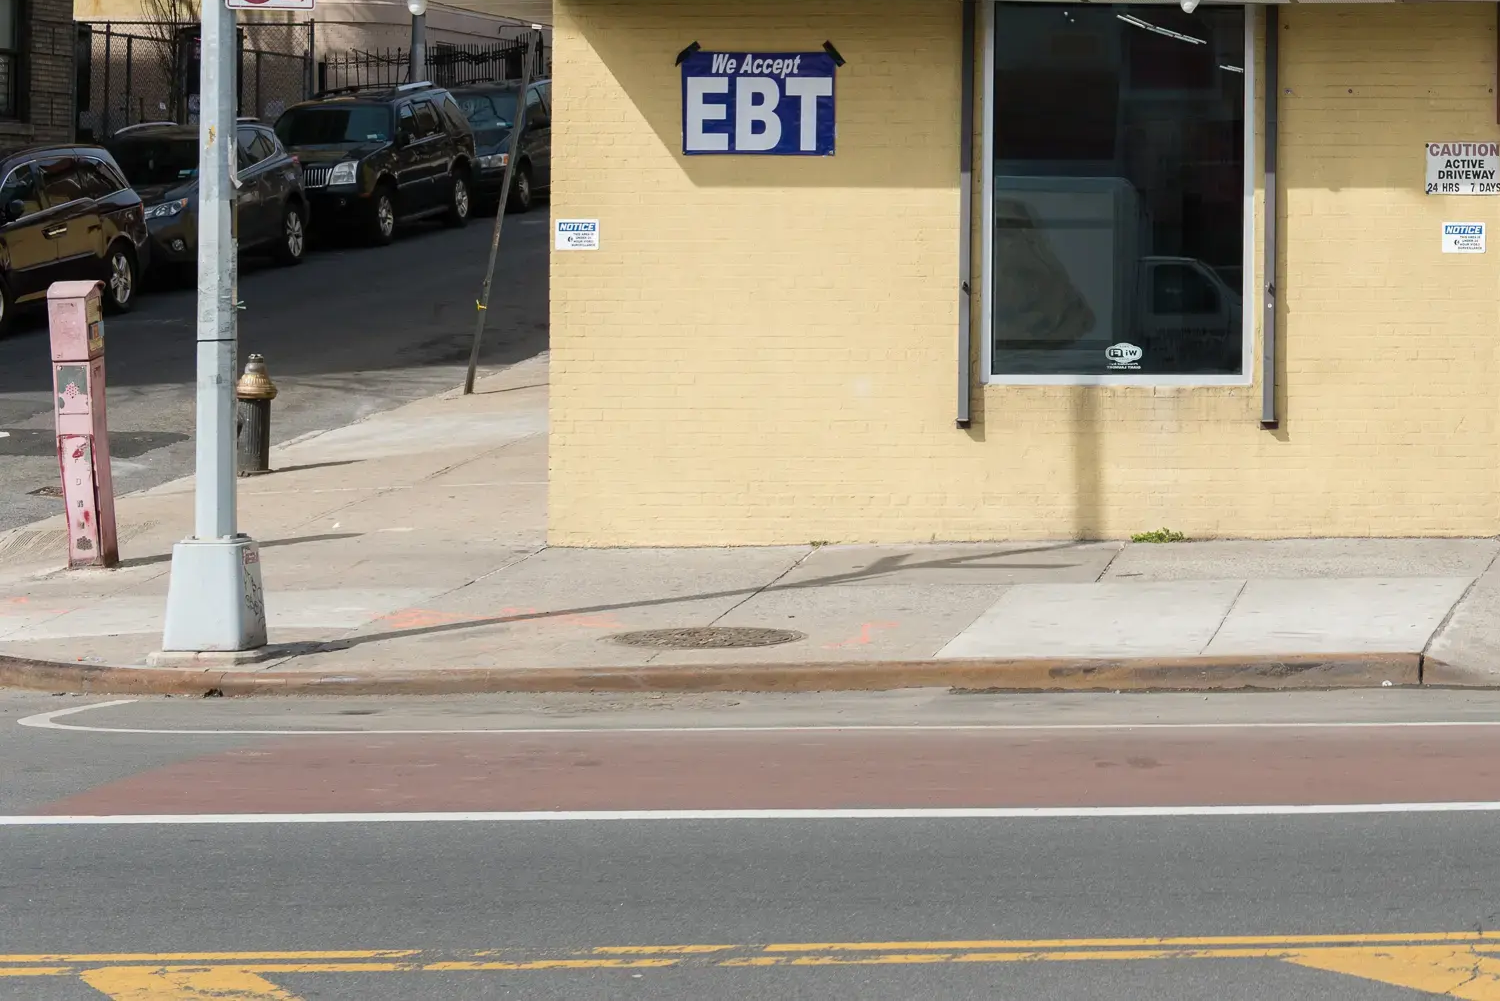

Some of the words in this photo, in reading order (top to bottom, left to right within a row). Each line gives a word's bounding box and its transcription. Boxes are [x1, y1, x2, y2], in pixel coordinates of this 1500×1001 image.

[711, 53, 736, 74] We
[739, 53, 801, 79] Accept
[686, 77, 833, 151] EBT
[1429, 143, 1500, 157] CAUTION
[1445, 159, 1485, 169] ACTIVE
[1438, 170, 1495, 180] DRIVEWAY
[1428, 183, 1438, 192] 24
[1442, 183, 1460, 192] HRS
[1470, 183, 1475, 192] 7
[560, 223, 595, 231] NOTICE
[1445, 226, 1482, 234] NOTICE
